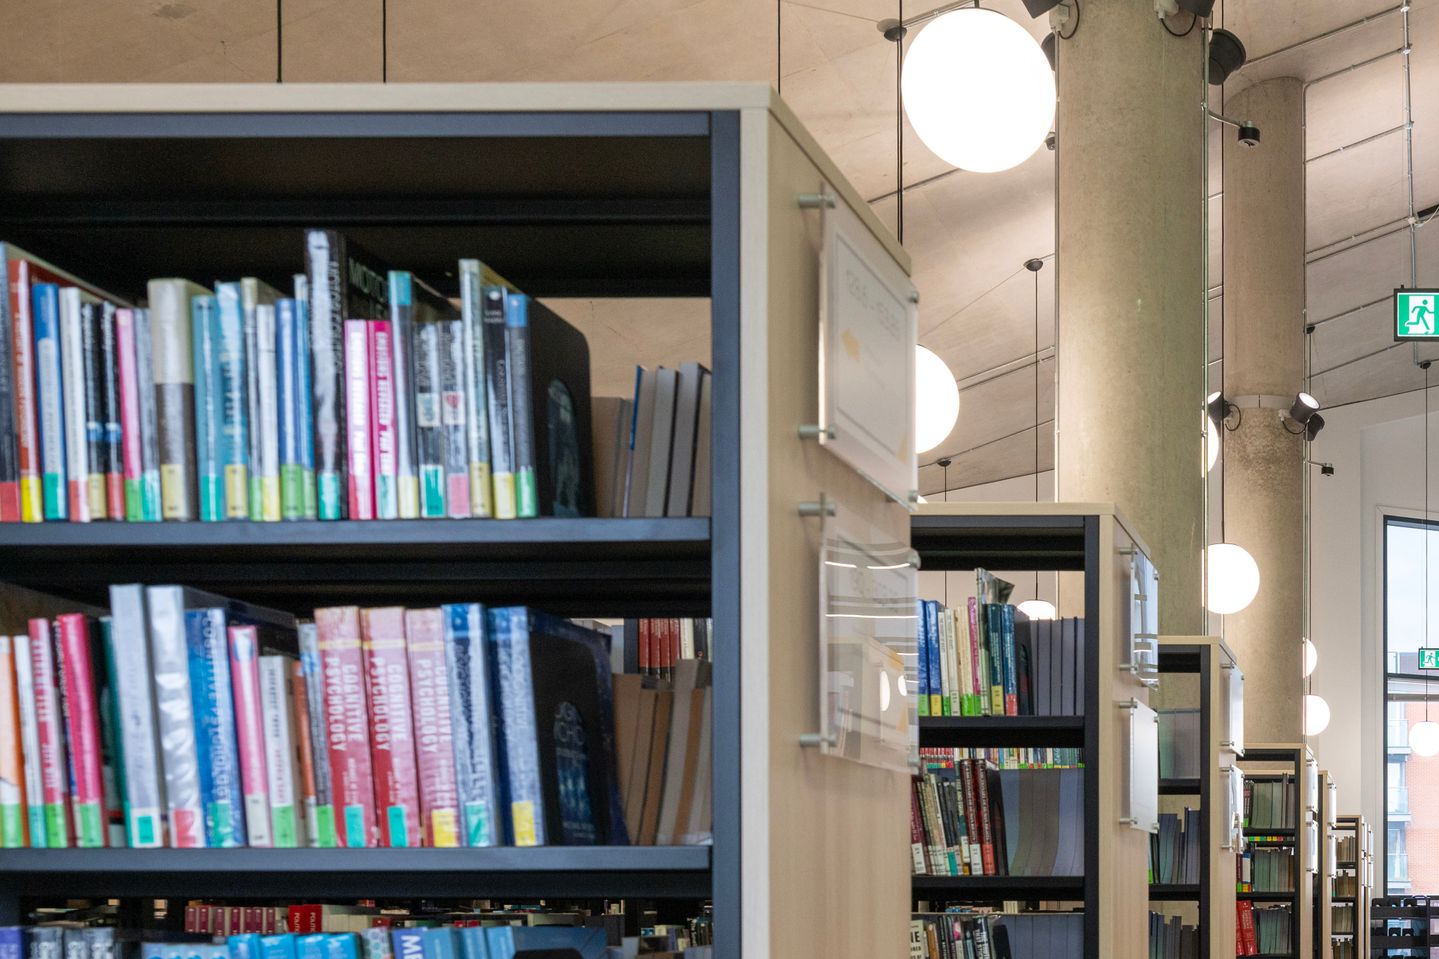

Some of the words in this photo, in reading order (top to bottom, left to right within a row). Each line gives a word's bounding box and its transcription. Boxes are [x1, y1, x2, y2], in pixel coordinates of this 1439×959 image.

[202, 616, 220, 701] COGNITIVE
[324, 657, 346, 751] PSYCHOLOGY
[342, 664, 363, 742] COGNITIVE
[370, 657, 389, 751] PSYCHOLOGY
[387, 664, 406, 742] COGNITIVE
[416, 658, 436, 753] PSYCHOLOGY
[207, 707, 230, 803] PSYCHOLOGY
